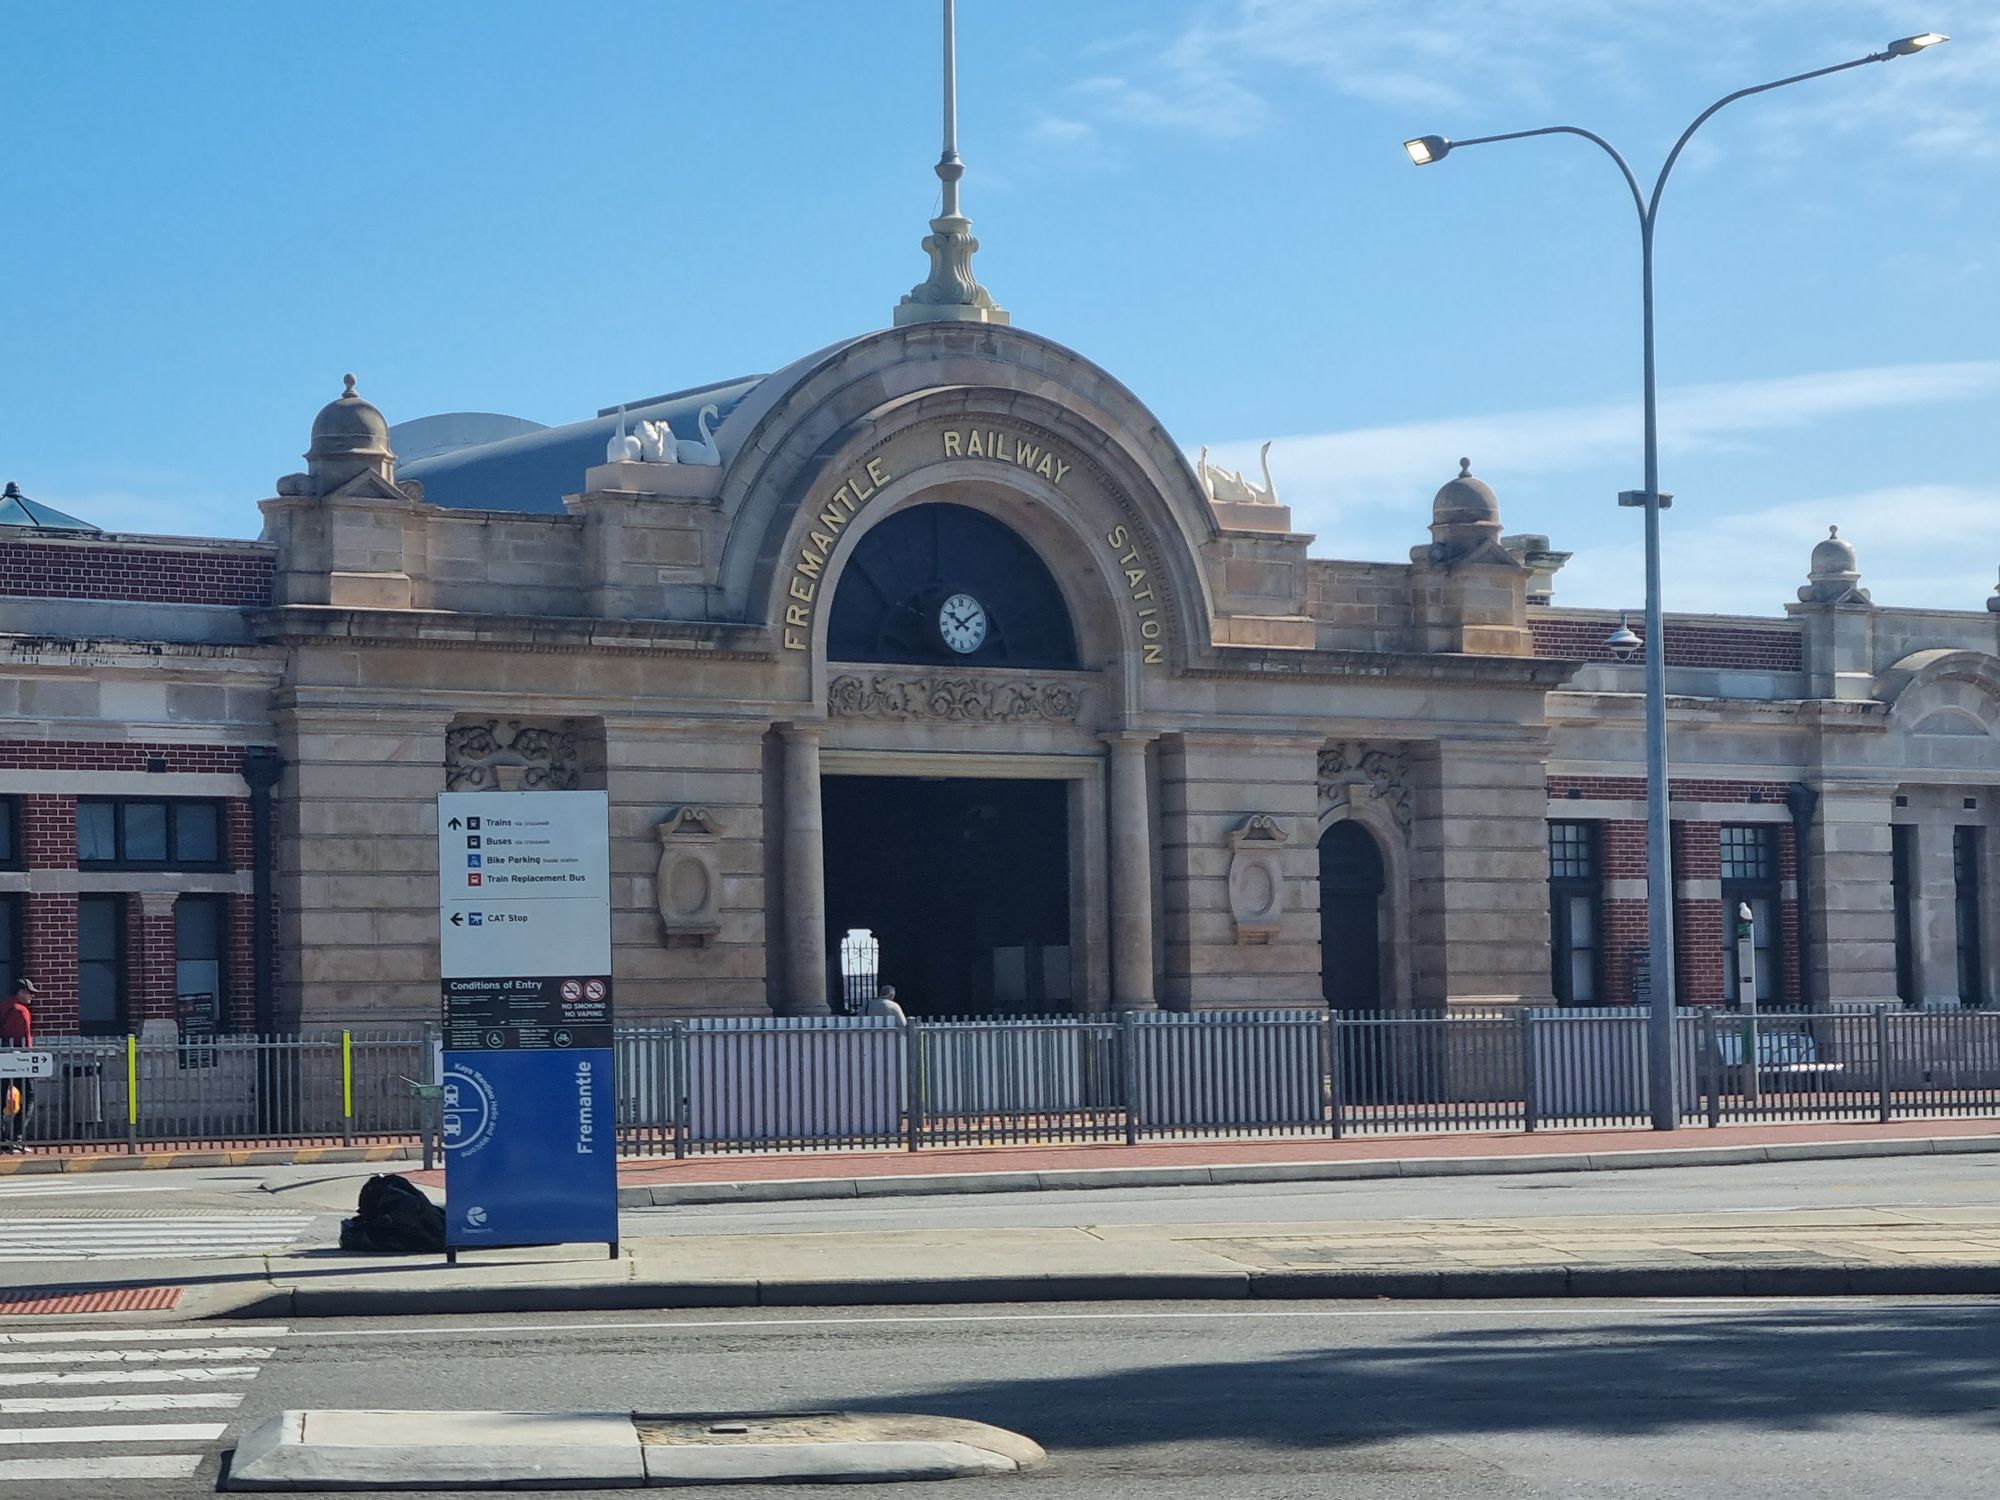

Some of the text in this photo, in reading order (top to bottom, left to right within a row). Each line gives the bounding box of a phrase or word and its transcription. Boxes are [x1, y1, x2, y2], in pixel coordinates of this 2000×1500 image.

[784, 456, 892, 651] FREMANTLE
[942, 429, 1072, 485] RAILWAY
[1106, 524, 1164, 666] STATION
[486, 819, 512, 827] Trains
[486, 837, 513, 846] Buses
[487, 856, 505, 864] Bike
[508, 855, 541, 865] Parking
[487, 873, 586, 884] Train Replacement Bus
[487, 914, 528, 923] CAT Stop
[450, 980, 543, 991] Conditions of Entry
[573, 1002, 606, 1010] SMOKING
[454, 1063, 474, 1075] Kaya
[490, 1100, 499, 1120] Hello
[576, 1061, 593, 1155] Fremantle
[486, 1122, 497, 1136] and
[460, 1135, 491, 1158] Welcome
